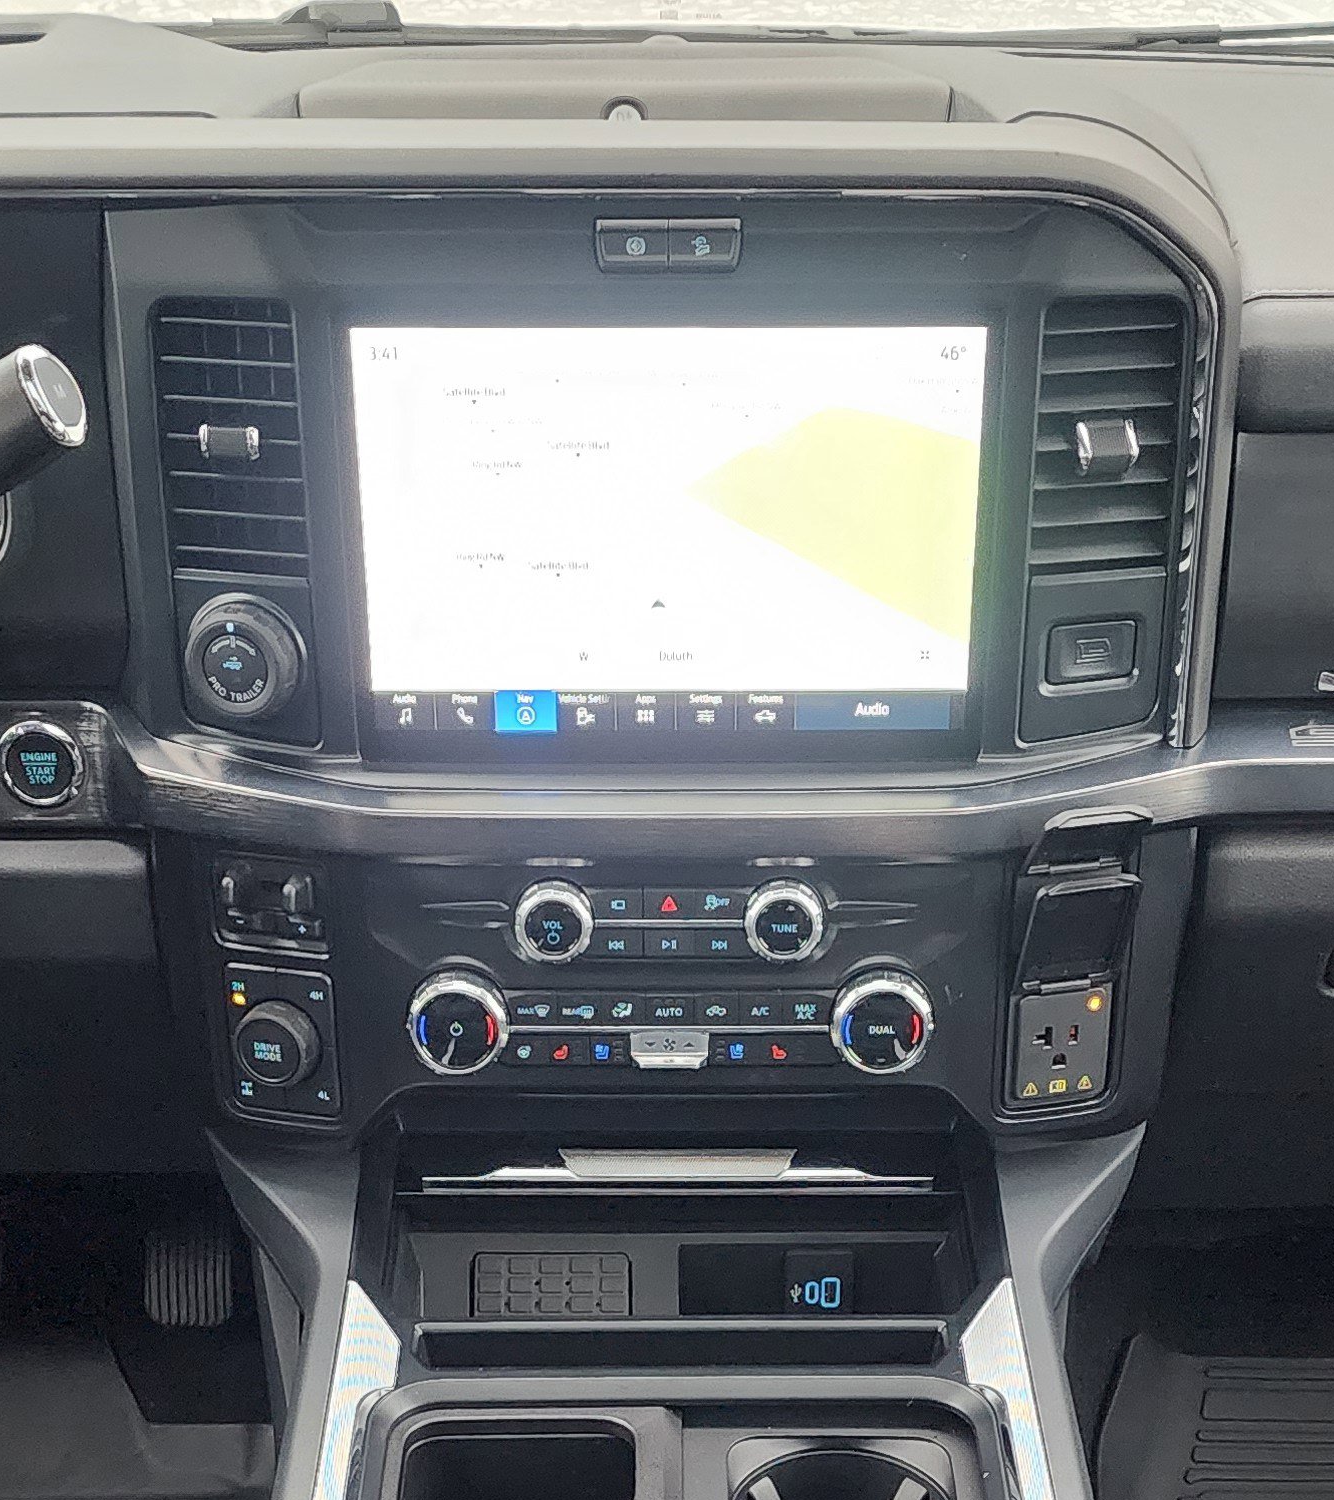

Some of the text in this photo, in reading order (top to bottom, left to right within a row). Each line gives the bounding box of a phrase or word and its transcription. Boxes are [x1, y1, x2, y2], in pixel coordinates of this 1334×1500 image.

[659, 650, 693, 662] Duluth
[208, 676, 265, 702] PRO TRAILER
[392, 693, 417, 704] Audio
[451, 693, 478, 704] Phone
[689, 693, 723, 705] Settings
[854, 701, 890, 717] Audio
[19, 752, 58, 762] ENGINE
[25, 766, 56, 776] START
[28, 774, 56, 785] STOP
[542, 919, 563, 930] VOL
[771, 923, 798, 934] TUNE
[231, 981, 245, 992] 2H
[308, 990, 324, 1001] 4H
[517, 1007, 535, 1015] MAX
[655, 1008, 683, 1017] AUTO
[750, 1006, 770, 1016] A/C
[794, 1004, 818, 1013] MAX
[796, 1011, 816, 1021] A/C
[869, 1025, 896, 1035] DUAL
[253, 1041, 281, 1054] DRIVE
[254, 1051, 283, 1062] MODE
[317, 1090, 331, 1101] 4L
